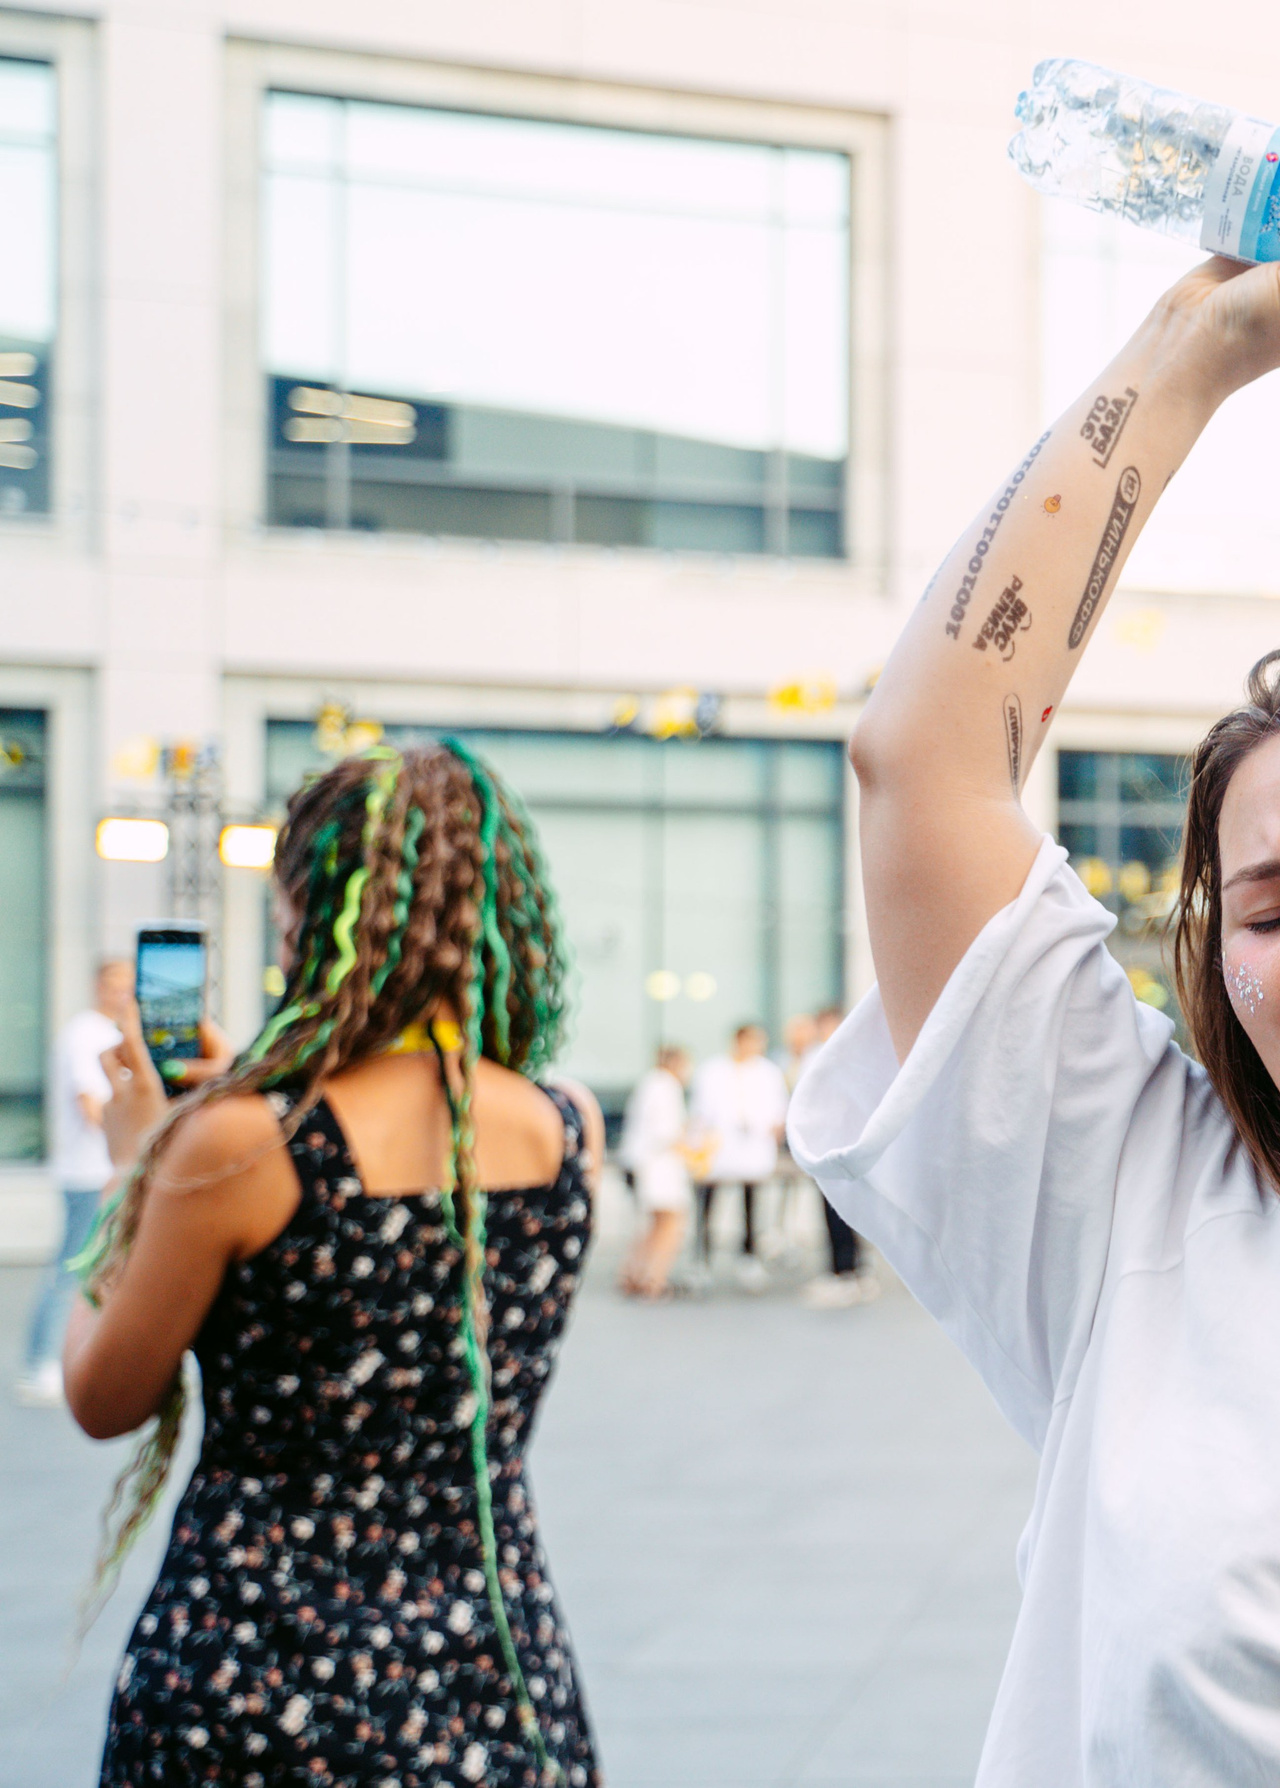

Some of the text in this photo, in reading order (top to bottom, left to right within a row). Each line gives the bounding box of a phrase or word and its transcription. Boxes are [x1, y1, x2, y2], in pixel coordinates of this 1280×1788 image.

[1231, 155, 1254, 197] ВОДА
[1080, 395, 1109, 440] ЭТО
[1091, 398, 1128, 455] БАЗА
[1071, 505, 1130, 644] ТИНЬКОФФ
[972, 574, 1023, 652] РЕЛИЗА
[994, 597, 1028, 652] ВКУС
